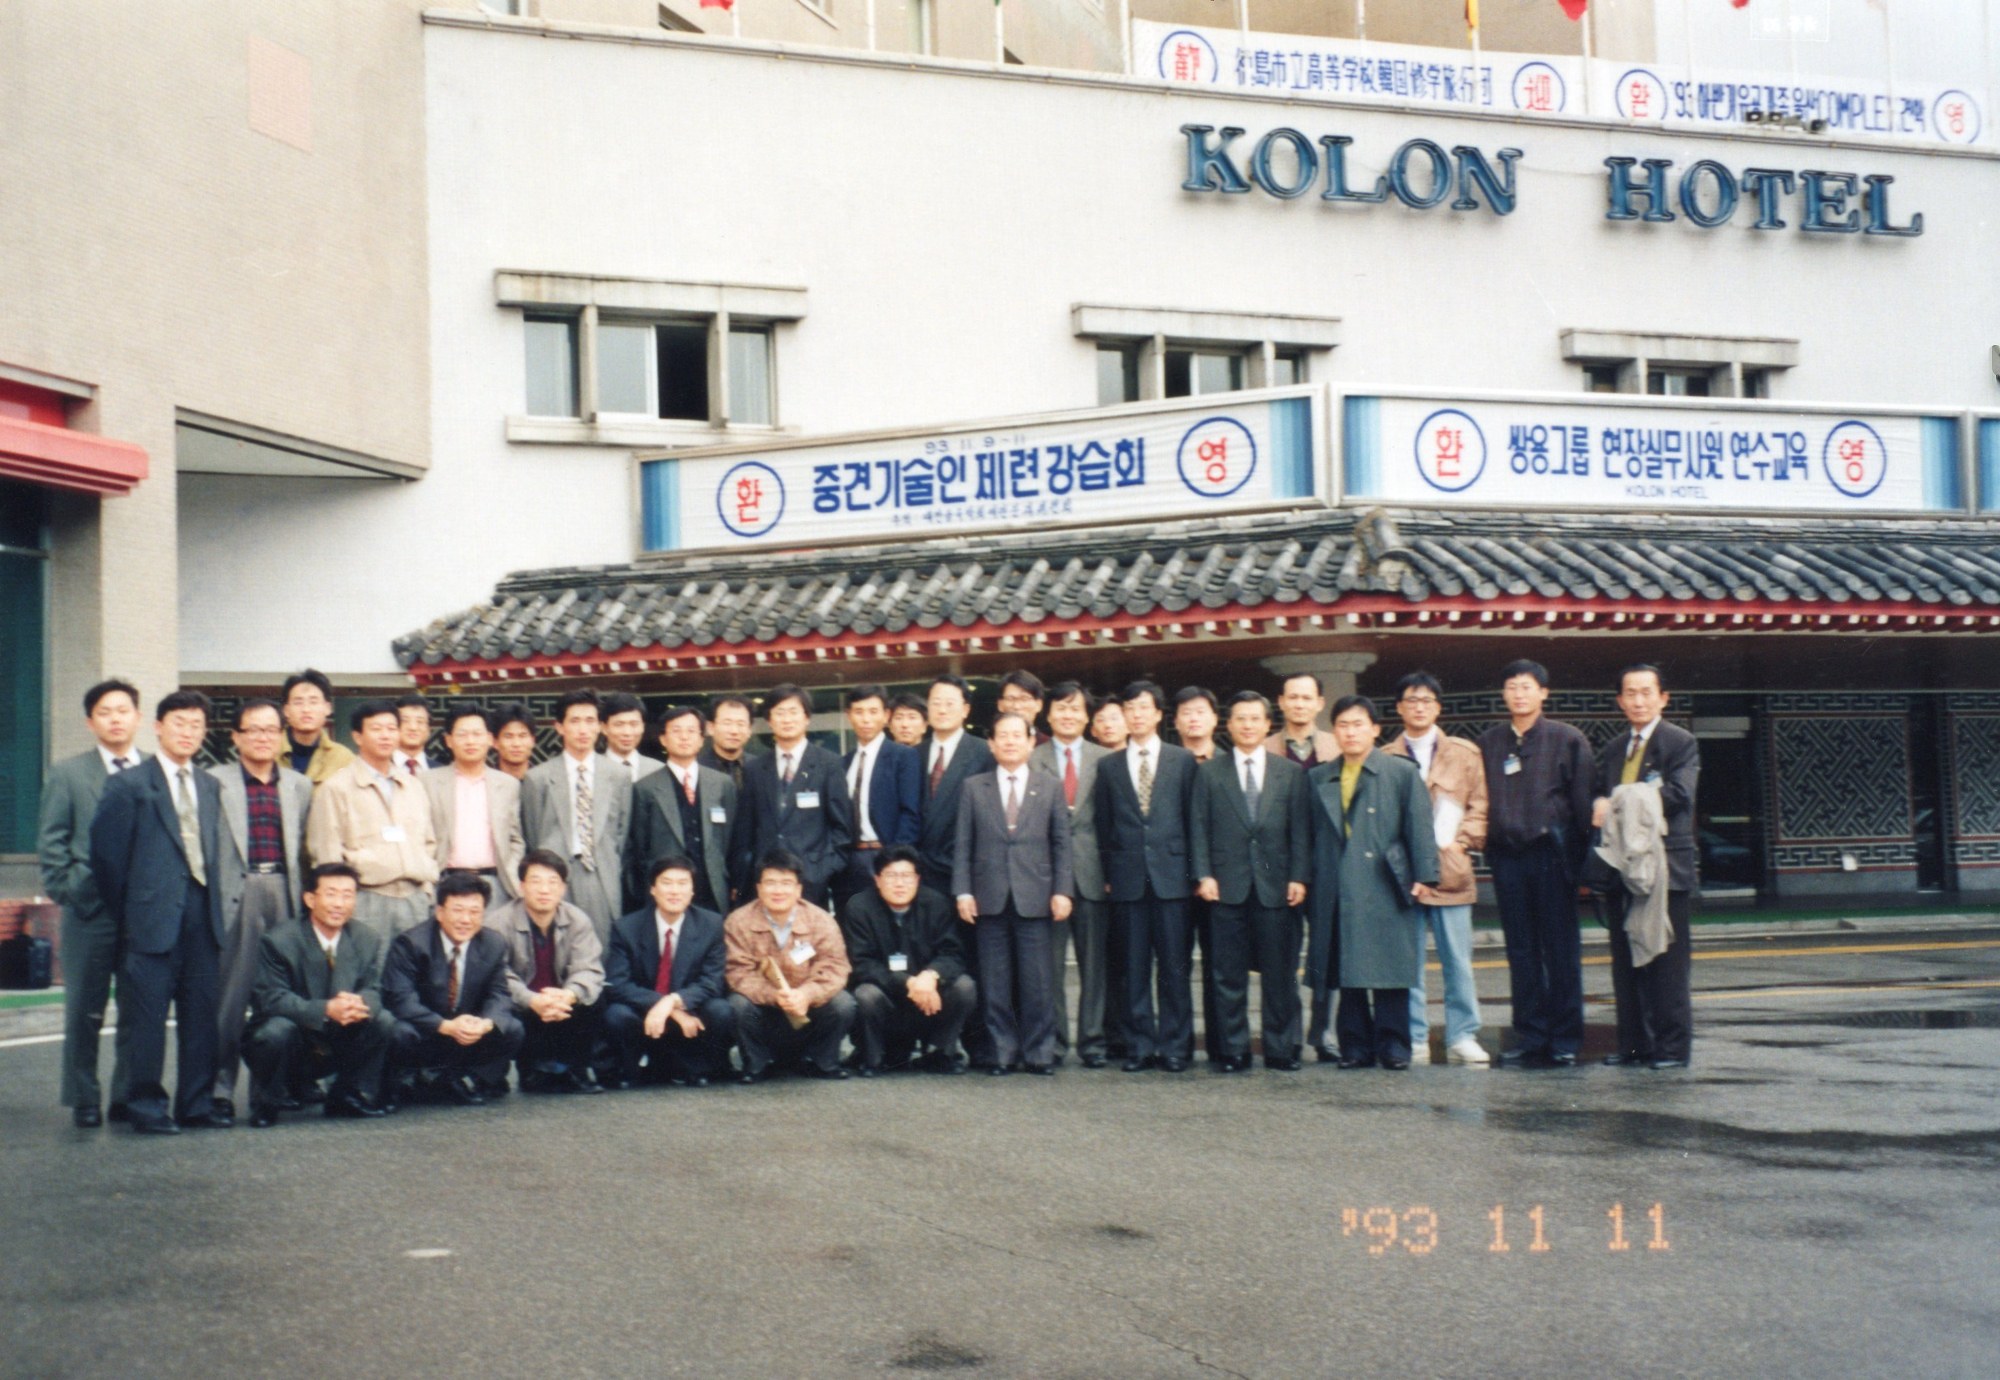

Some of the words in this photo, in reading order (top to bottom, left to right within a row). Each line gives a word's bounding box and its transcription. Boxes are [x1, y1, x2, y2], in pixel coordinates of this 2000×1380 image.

[1523, 73, 1552, 112] 迎
[1629, 80, 1650, 118] 환
[1945, 102, 1965, 135] 영
[1179, 124, 1524, 216] KOLON
[1603, 156, 1924, 236] HOTEL
[736, 477, 764, 524] 환
[813, 455, 967, 513] 중견기술인
[1196, 436, 1228, 483] 영
[1435, 427, 1464, 478] 환
[1508, 424, 1591, 477] 쌍용그룹
[1602, 426, 1725, 481] 현장실무사원
[1729, 431, 1809, 481] 연수교육
[1839, 439, 1865, 483] 영
